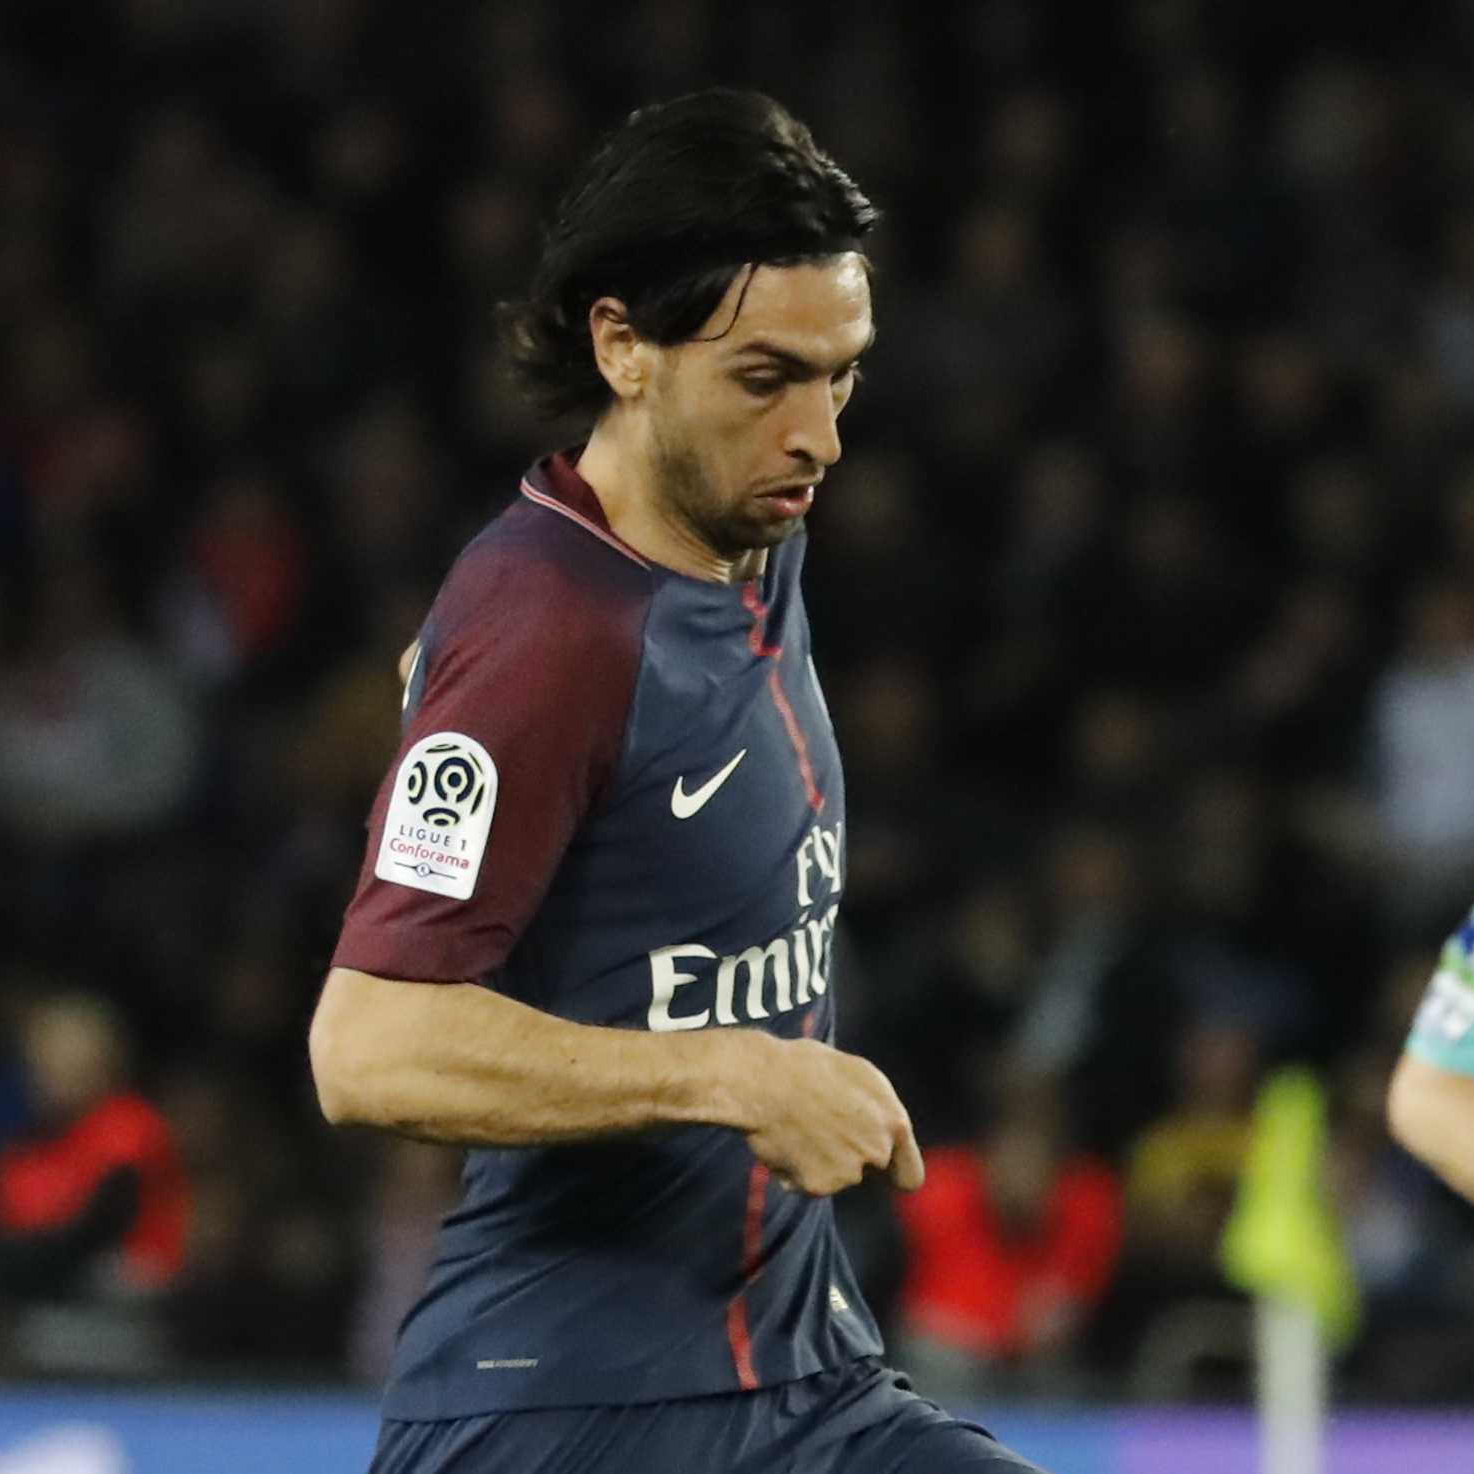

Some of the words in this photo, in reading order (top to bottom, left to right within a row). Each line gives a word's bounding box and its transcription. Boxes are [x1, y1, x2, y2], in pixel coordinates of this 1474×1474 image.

[399, 824, 451, 847] LIGUE
[461, 839, 467, 851] 1
[390, 838, 470, 869] Conforama
